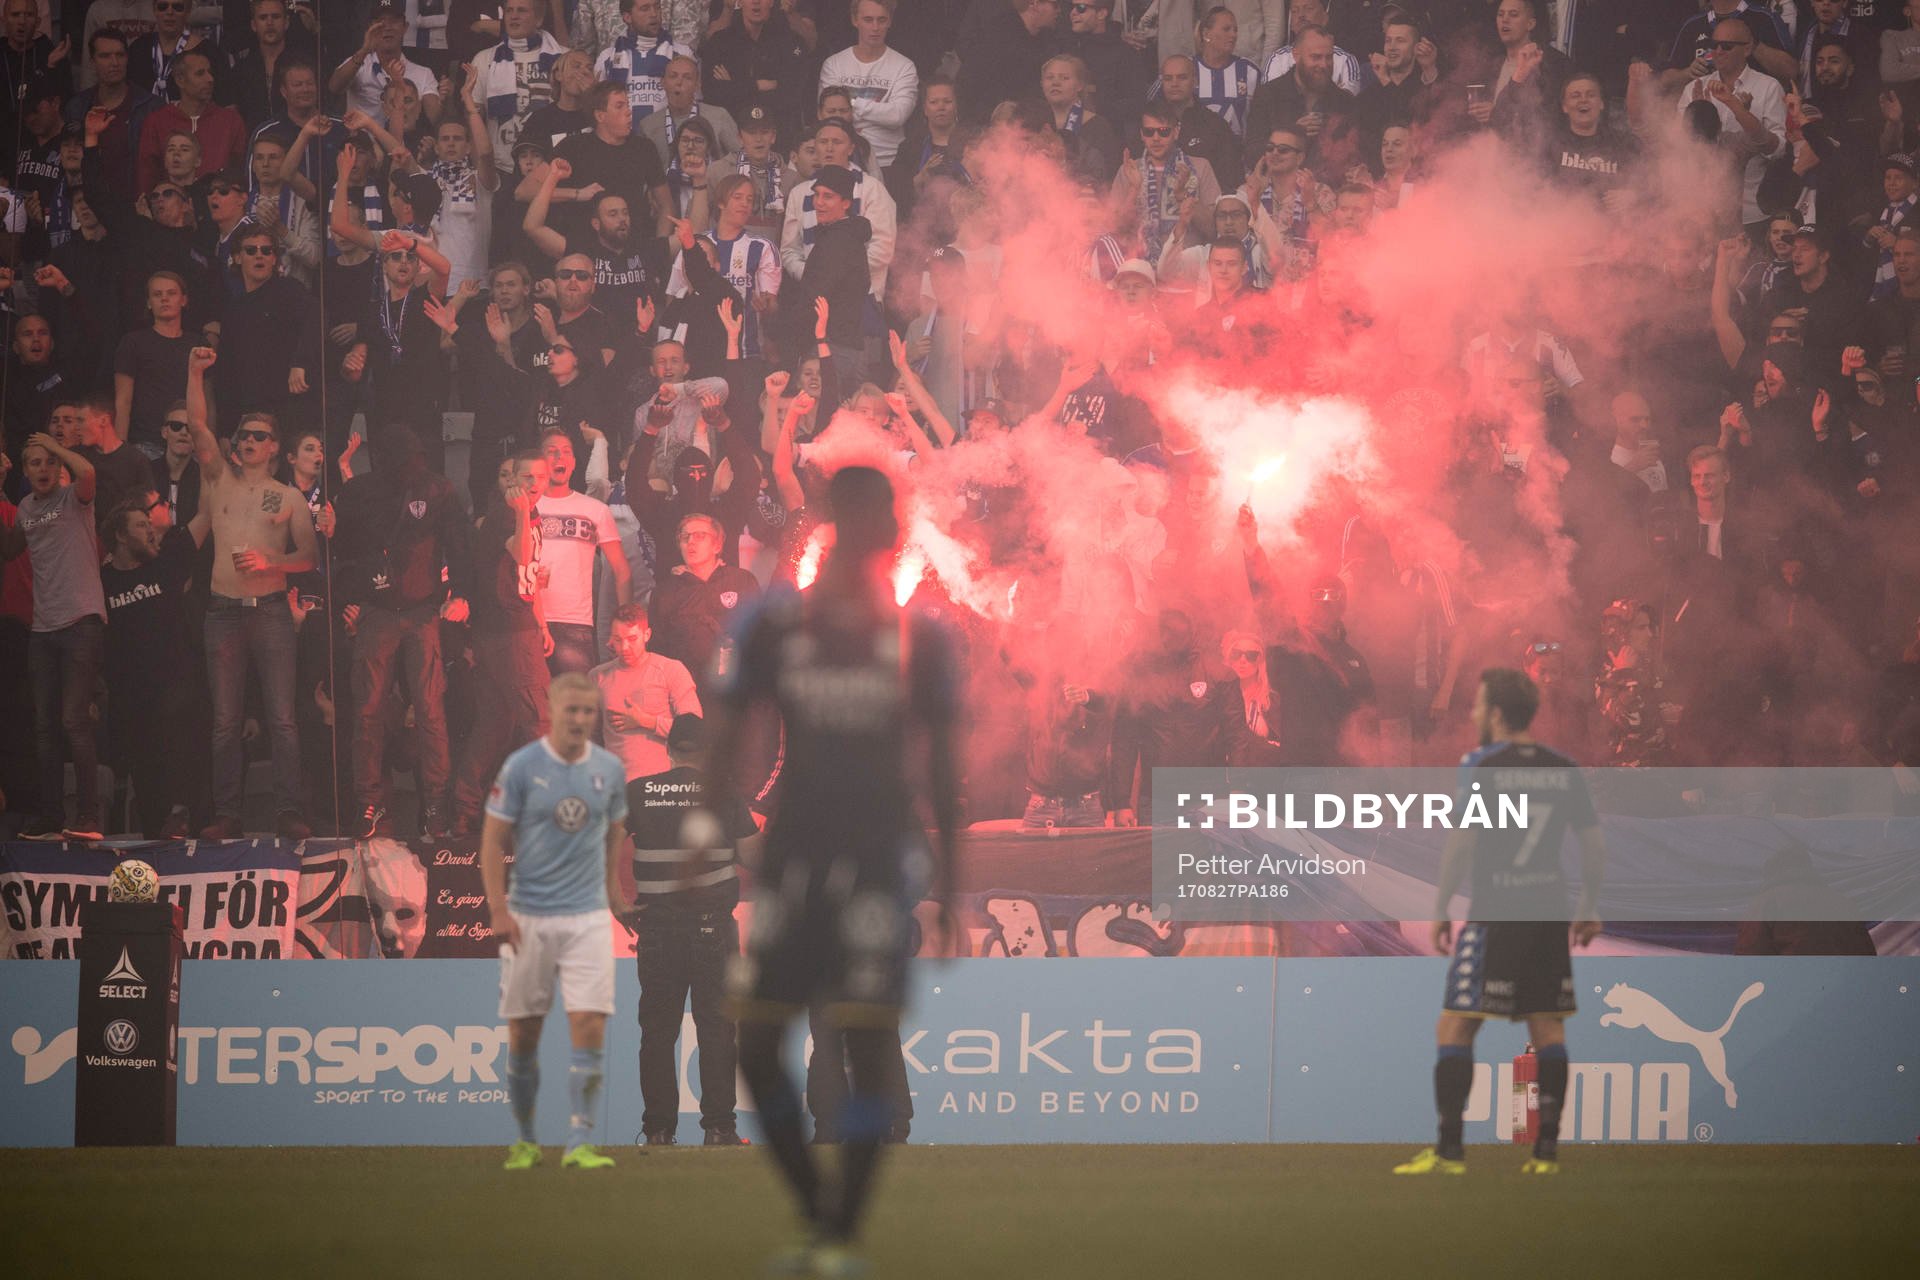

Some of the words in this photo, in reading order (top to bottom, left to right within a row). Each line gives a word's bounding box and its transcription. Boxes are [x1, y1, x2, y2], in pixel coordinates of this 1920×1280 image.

[595, 257, 612, 272] IFK
[433, 849, 477, 866] David
[203, 871, 289, 930] FÖR
[452, 892, 485, 909] gång
[99, 985, 147, 999] SELECT
[86, 1054, 157, 1068] Volkswagen
[313, 1089, 375, 1104] SPORT
[380, 1088, 406, 1104] TO
[413, 1088, 449, 1104] THE
[457, 1088, 512, 1105] PEOPL
[938, 1090, 1017, 1113] AND
[1041, 1090, 1200, 1113] BEYOND
